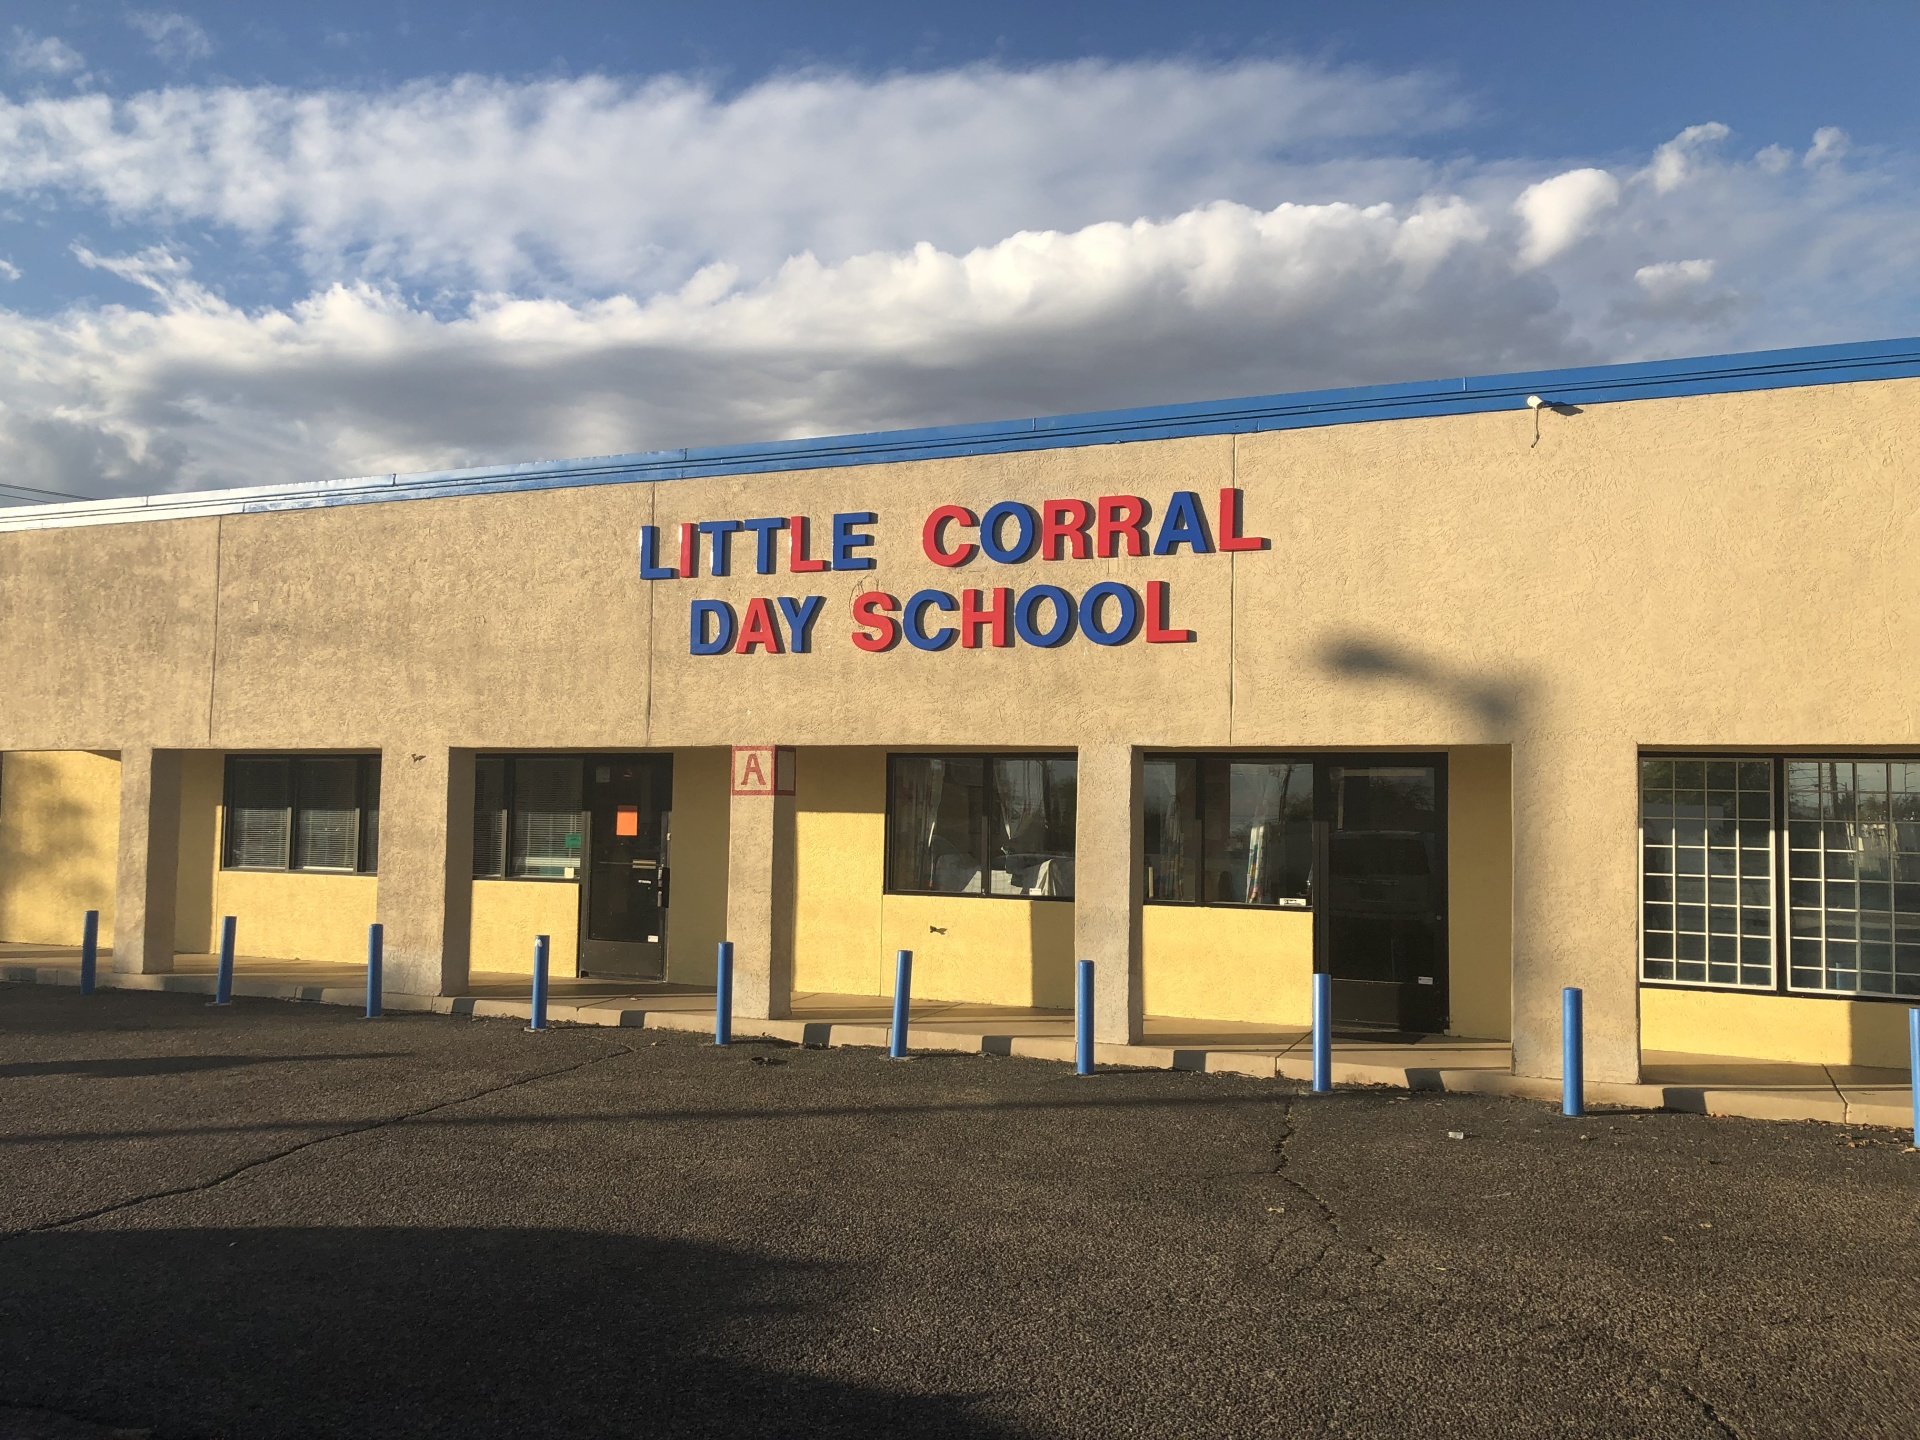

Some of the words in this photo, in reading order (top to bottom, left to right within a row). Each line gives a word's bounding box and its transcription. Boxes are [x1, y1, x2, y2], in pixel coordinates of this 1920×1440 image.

[640, 512, 876, 580] LITTLE
[922, 488, 1271, 567] CORRAL
[690, 595, 826, 655] DAY
[851, 581, 1197, 652] SCHOOL
[741, 753, 766, 786] A
